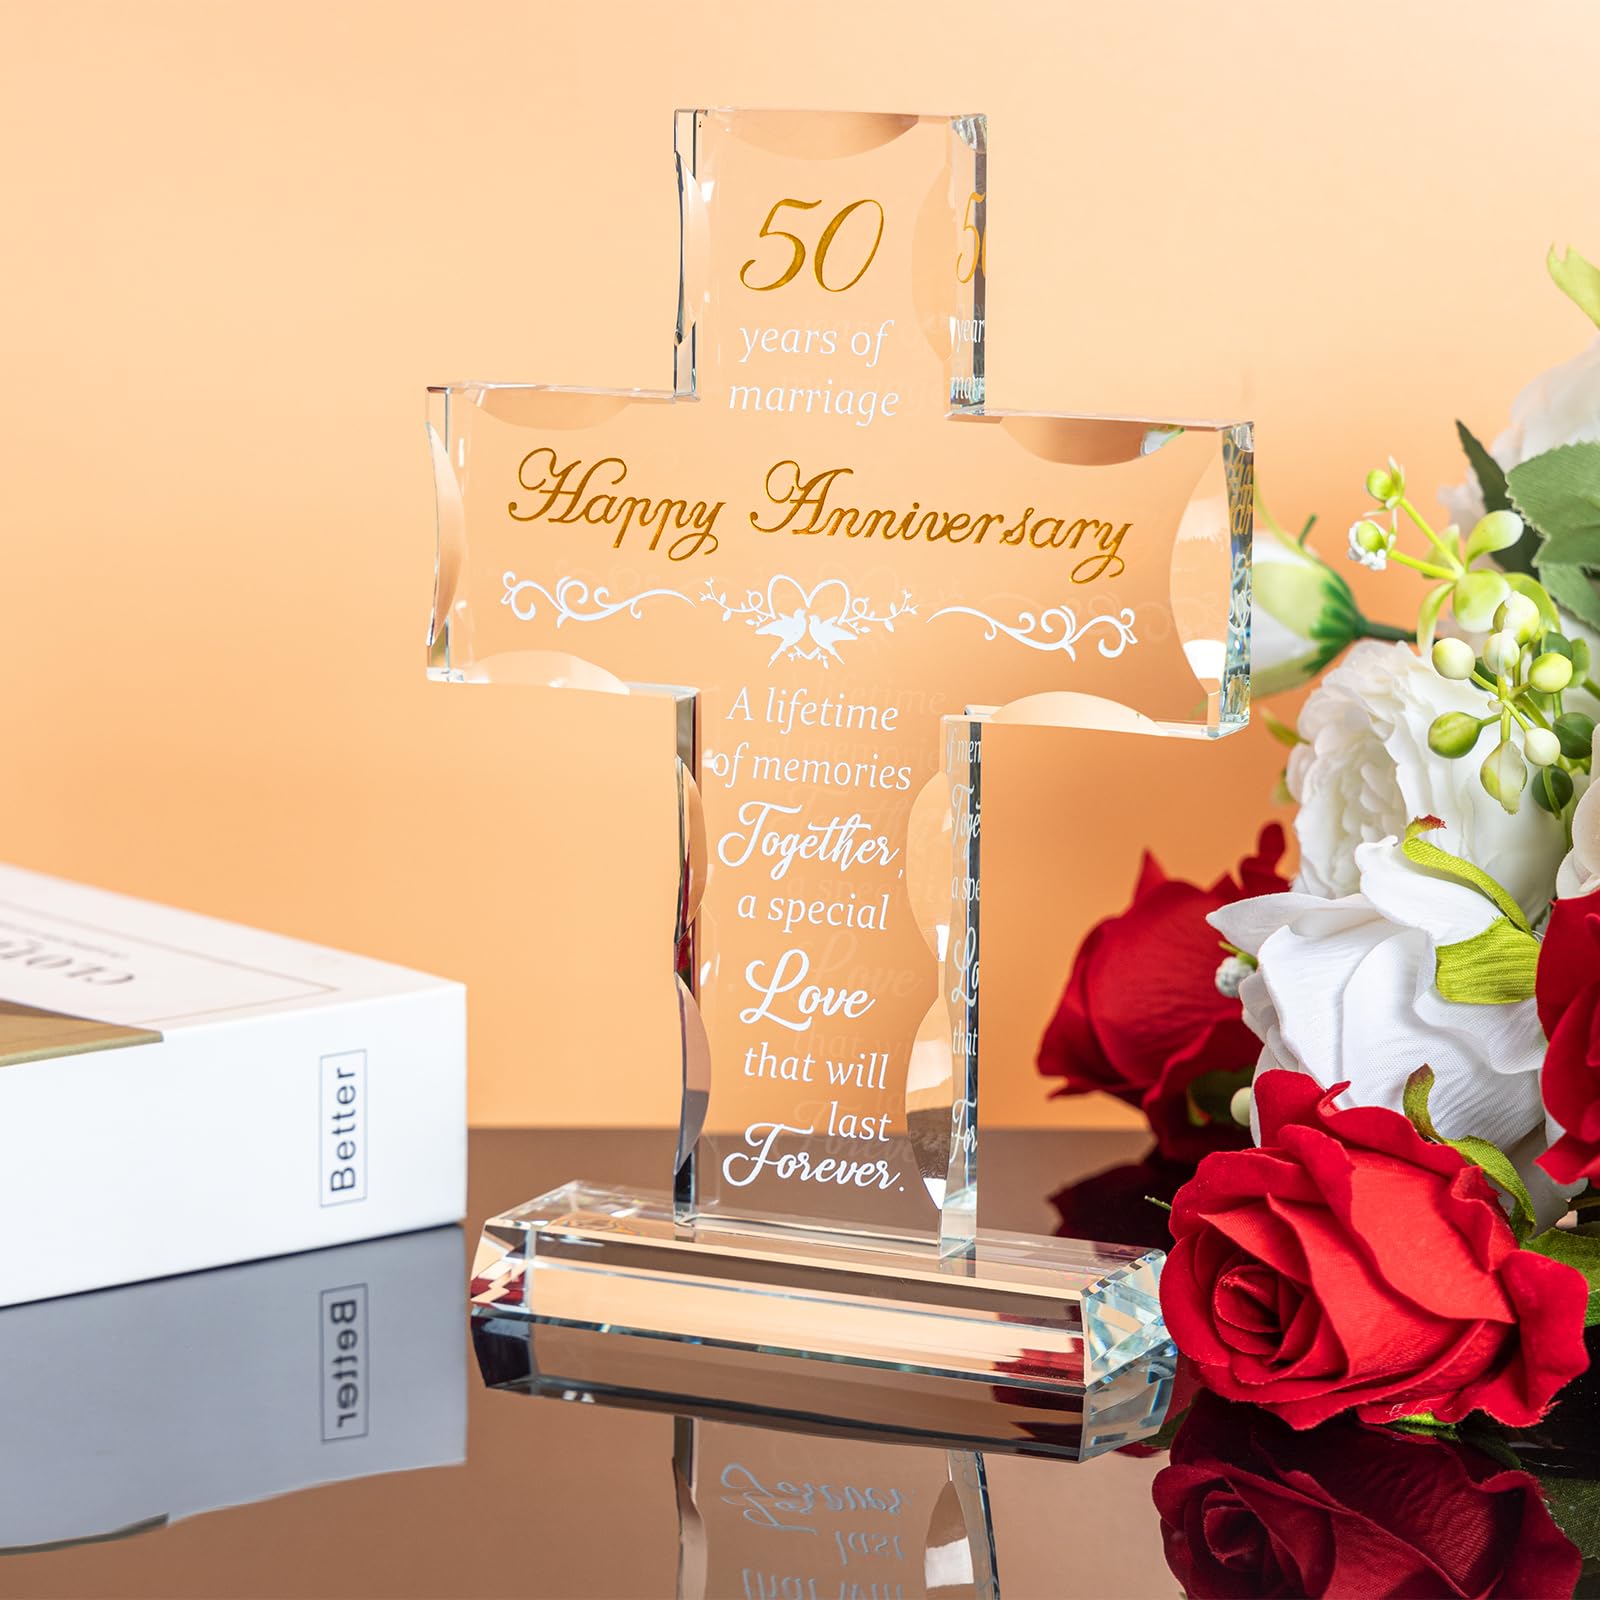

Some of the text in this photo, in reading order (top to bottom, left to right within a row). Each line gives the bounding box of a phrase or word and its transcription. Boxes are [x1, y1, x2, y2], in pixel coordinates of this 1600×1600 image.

[739, 198, 885, 293] 50
[738, 319, 896, 369] years of
[729, 378, 900, 427] marriage
[507, 447, 727, 562] Happy
[750, 459, 1134, 584] Anniversary
[725, 686, 755, 721] A
[765, 686, 899, 736] lifetime
[711, 741, 750, 789] of
[752, 752, 912, 791] memories
[716, 800, 905, 881] Together,
[736, 892, 889, 934] a special
[738, 948, 876, 1033] Love
[743, 1041, 889, 1090] that will
[329, 1066, 357, 1193] Better
[827, 1100, 893, 1142] last
[721, 1121, 906, 1193] Forever.
